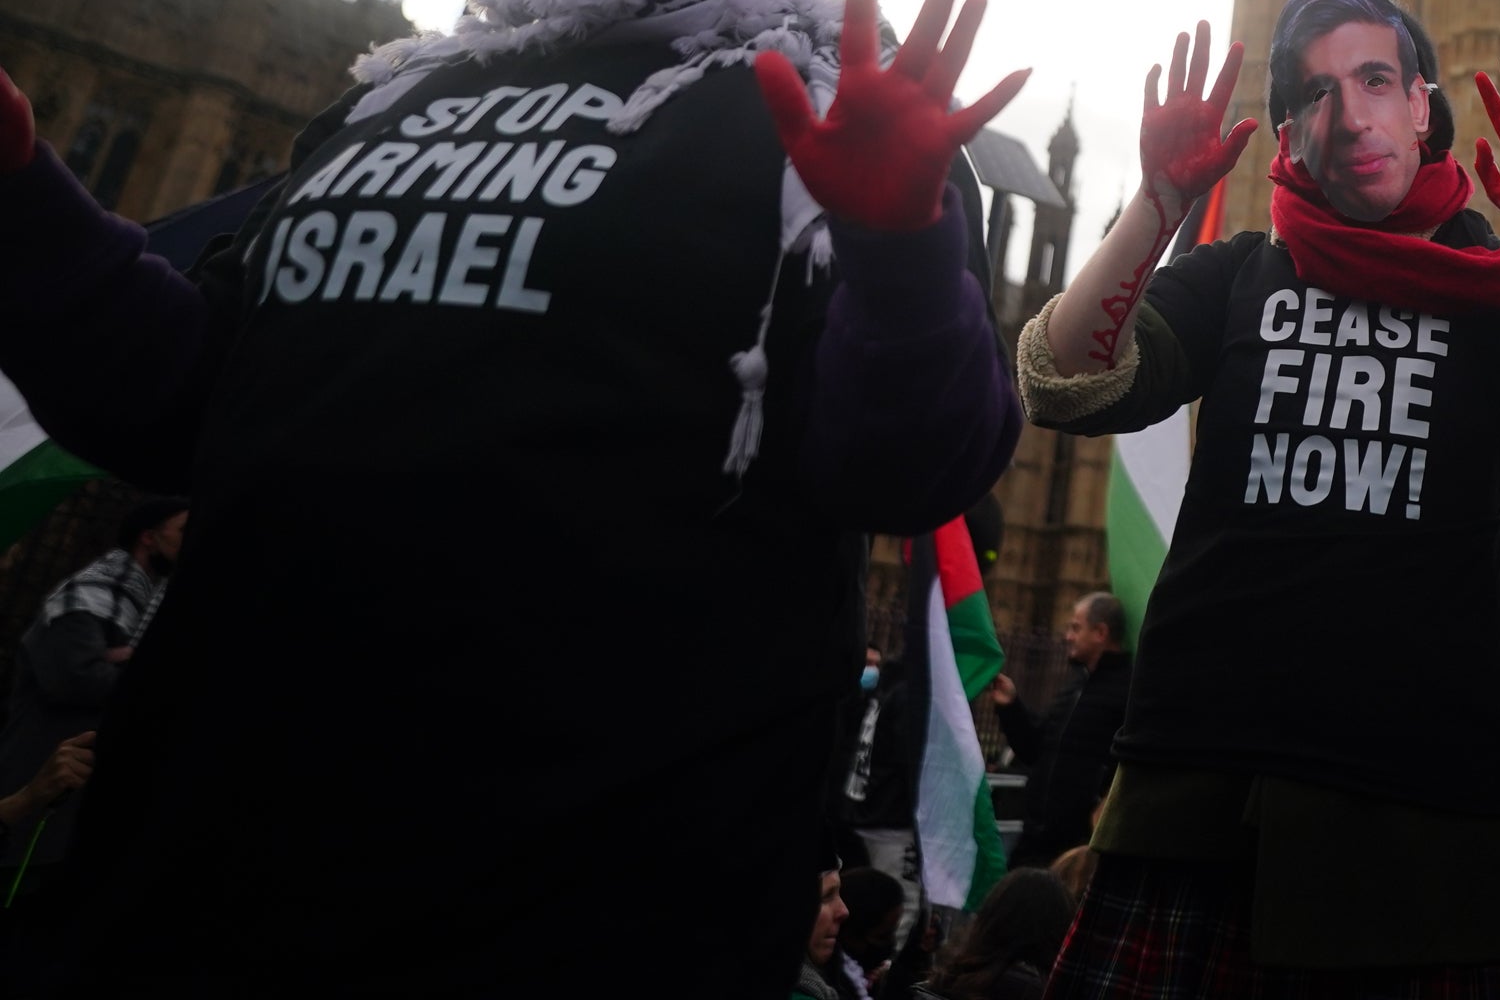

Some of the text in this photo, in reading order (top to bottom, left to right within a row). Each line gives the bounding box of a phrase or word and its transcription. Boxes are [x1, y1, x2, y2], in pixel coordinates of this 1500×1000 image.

[400, 82, 627, 138] STOP
[288, 139, 618, 207] ARMING
[259, 210, 552, 314] ISRAEL
[1260, 287, 1450, 357] CEASE
[1254, 349, 1436, 439] FIRE
[1244, 432, 1427, 520] NOW!
